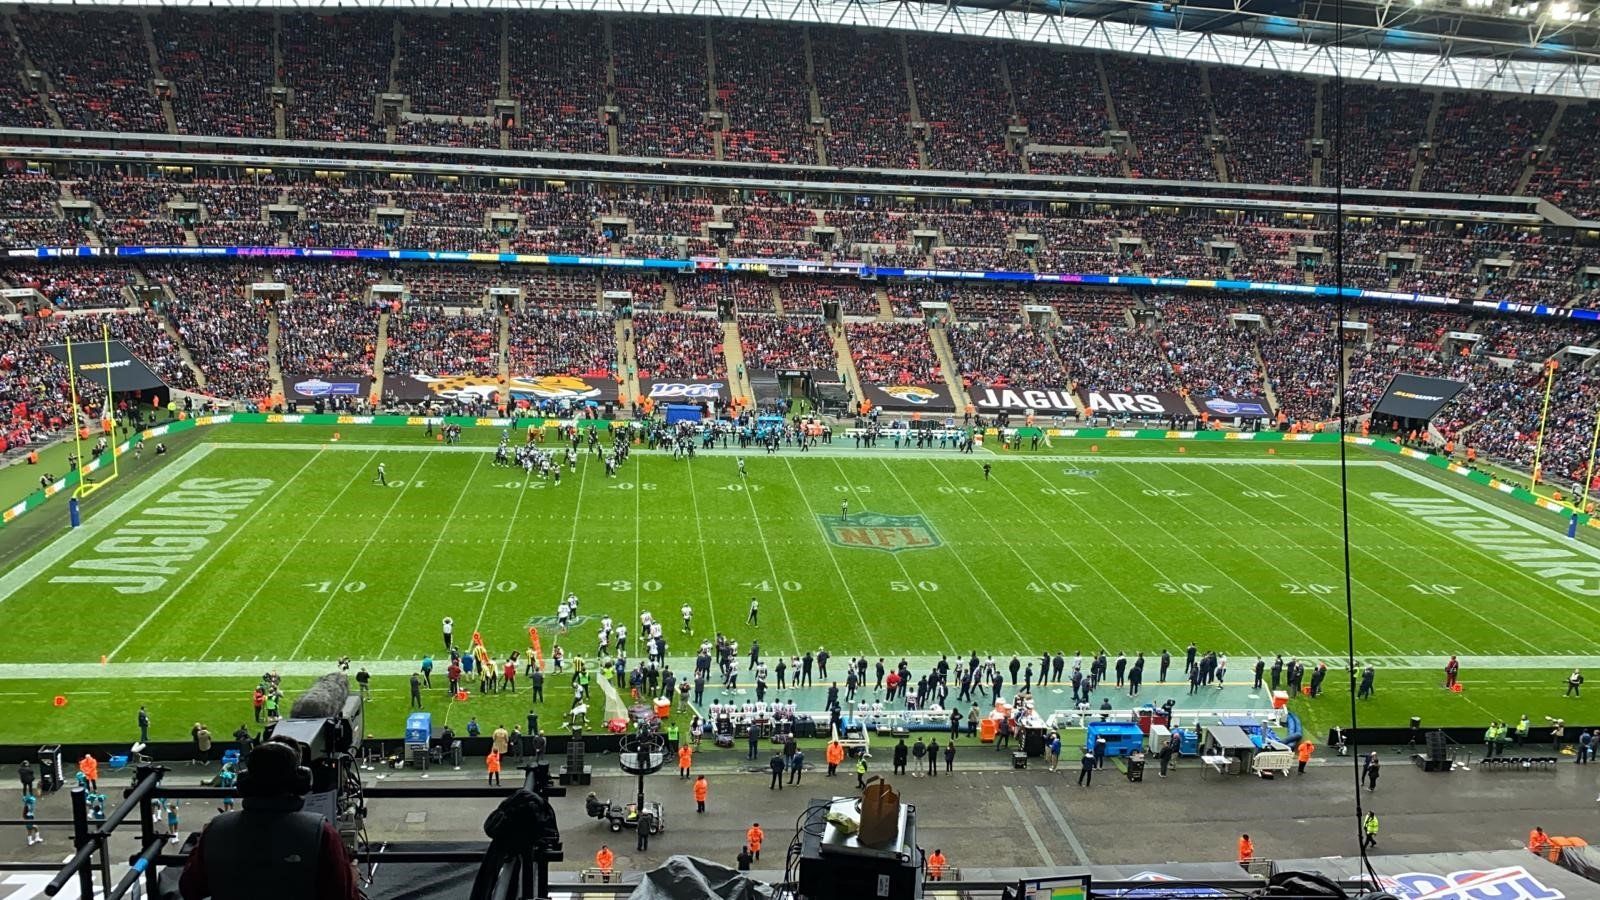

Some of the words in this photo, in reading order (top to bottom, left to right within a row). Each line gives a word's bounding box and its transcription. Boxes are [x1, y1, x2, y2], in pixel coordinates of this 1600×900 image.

[266, 414, 304, 423] SUBWAY
[337, 416, 374, 424] SUBWAY
[48, 478, 274, 594] JAGUARS
[838, 528, 931, 546] NFL
[314, 580, 367, 593] 10
[462, 580, 518, 592] 20
[611, 580, 663, 592] 30
[753, 580, 802, 592] 40
[890, 580, 939, 592] 50
[1025, 582, 1074, 593] 40
[1153, 582, 1205, 594] 30
[1280, 583, 1330, 594] 20
[1406, 584, 1454, 594] 10
